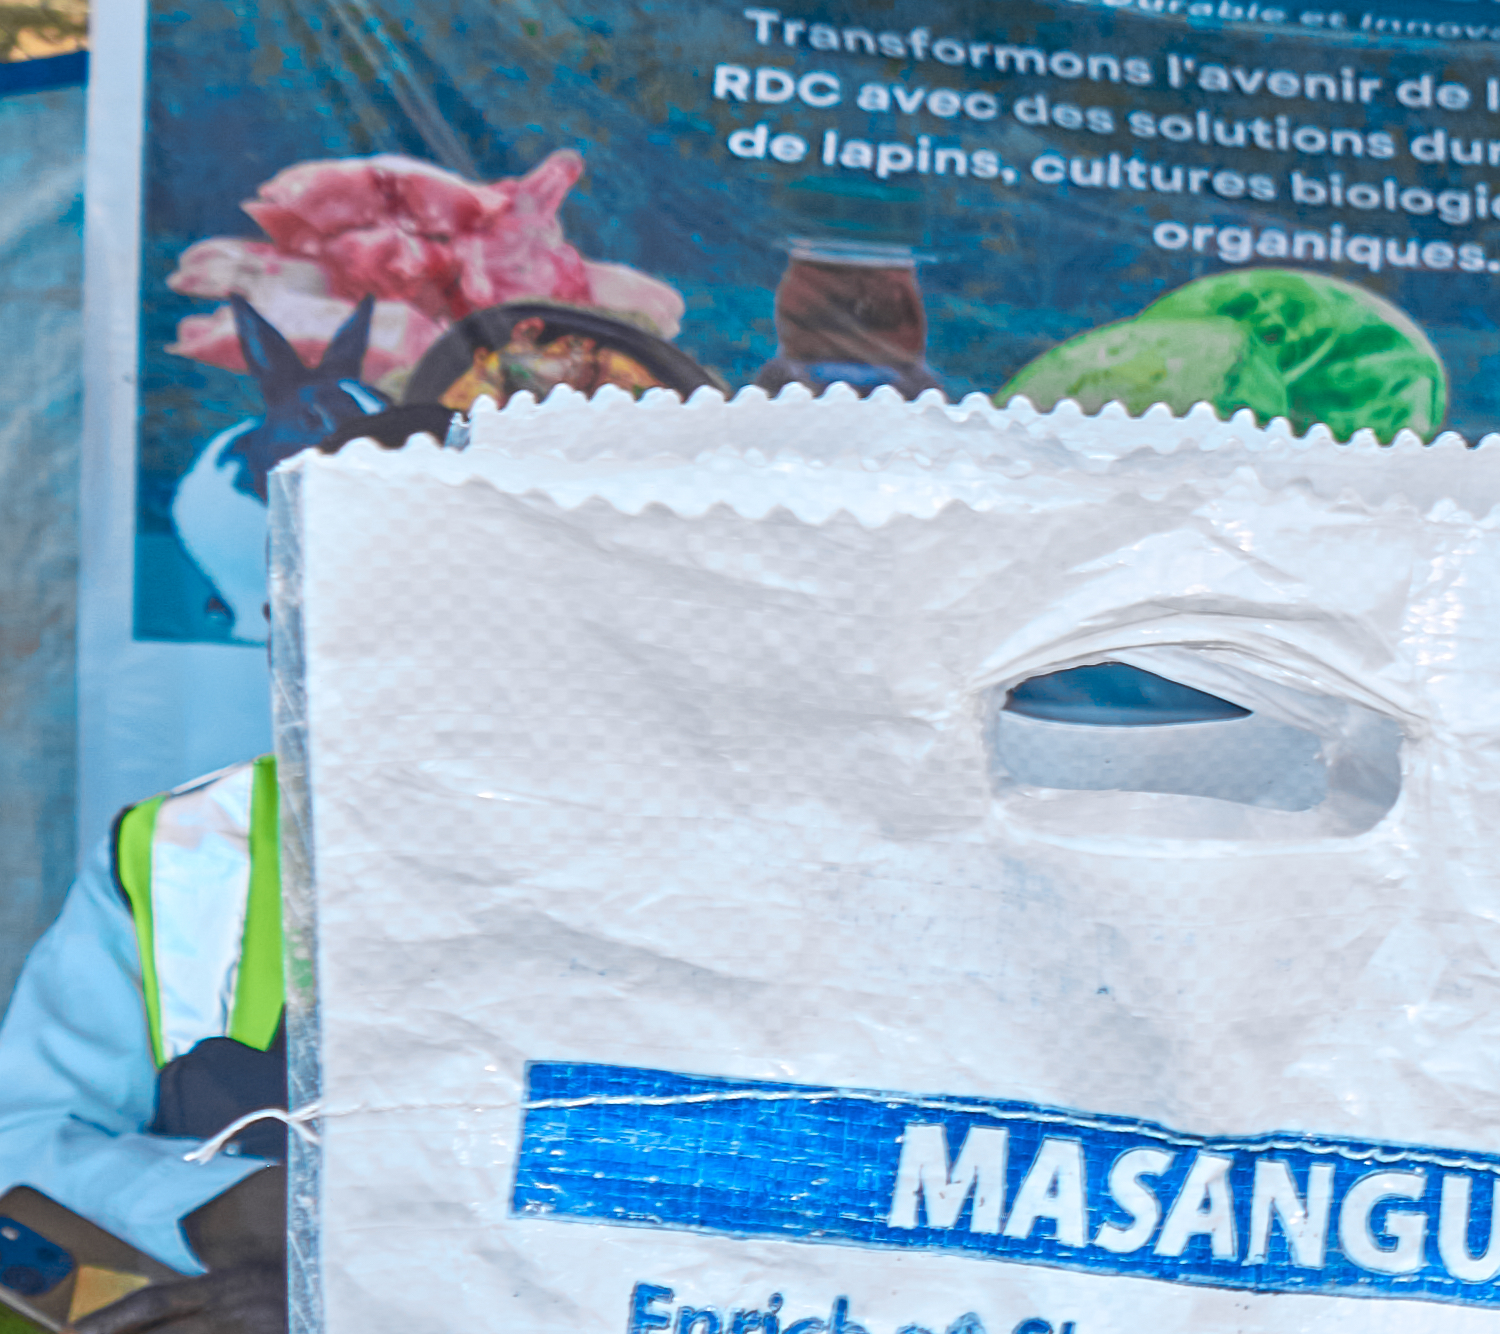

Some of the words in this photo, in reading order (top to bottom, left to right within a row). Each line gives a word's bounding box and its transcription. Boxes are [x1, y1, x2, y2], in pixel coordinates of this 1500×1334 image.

[743, 7, 1152, 86] Transformons
[1167, 53, 1382, 105] l'avenir
[1397, 73, 1471, 111] de
[1300, 9, 1346, 29] et
[712, 64, 841, 108] RDC
[856, 82, 1000, 121] avec
[1013, 93, 1117, 136] des
[1128, 108, 1396, 160] solutions
[727, 123, 809, 164] de
[822, 129, 1017, 186] lapins,
[1031, 153, 1276, 201] cultures
